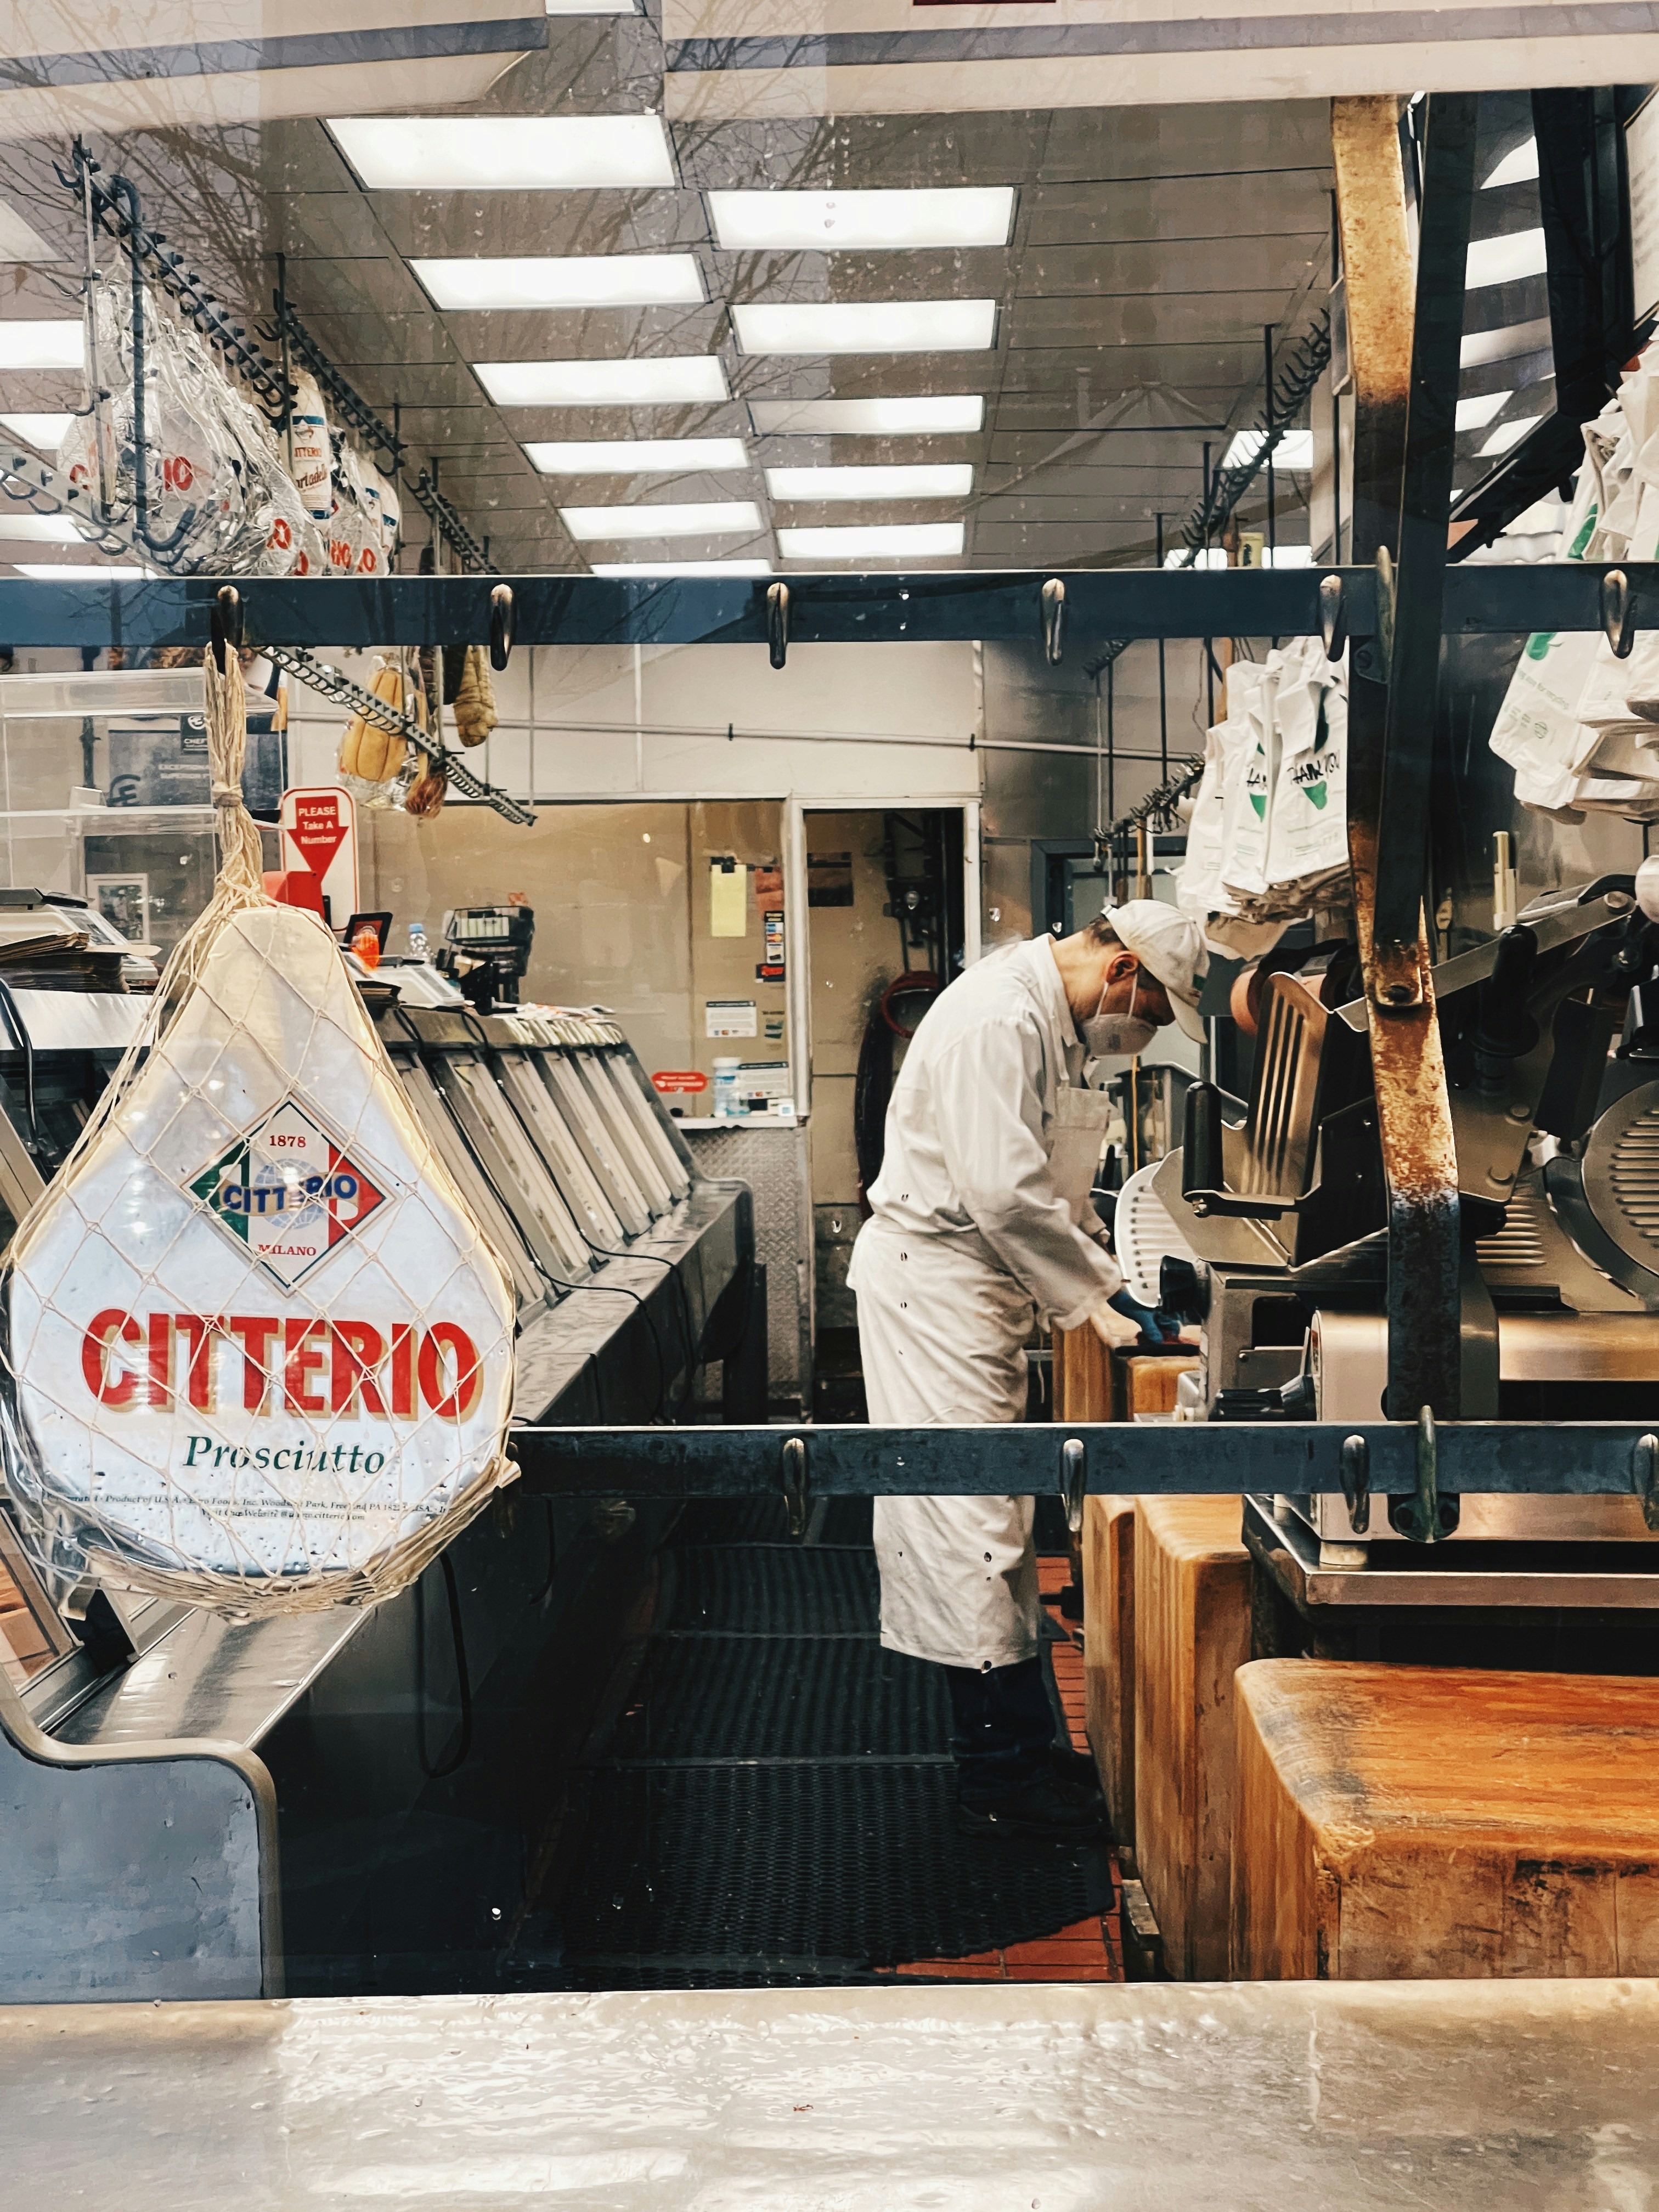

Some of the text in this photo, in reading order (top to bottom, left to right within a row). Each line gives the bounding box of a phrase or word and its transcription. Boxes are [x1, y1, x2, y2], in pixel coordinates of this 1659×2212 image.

[298, 806, 336, 817] PLEASE
[302, 820, 334, 830] Take A
[301, 836, 337, 844] Number
[269, 1135, 307, 1148] 1878
[223, 1175, 358, 1214] CITTRIO
[258, 1244, 317, 1256] MILANO
[82, 1309, 483, 1424] CITTERIO
[182, 1435, 385, 1475] Prosciutto
